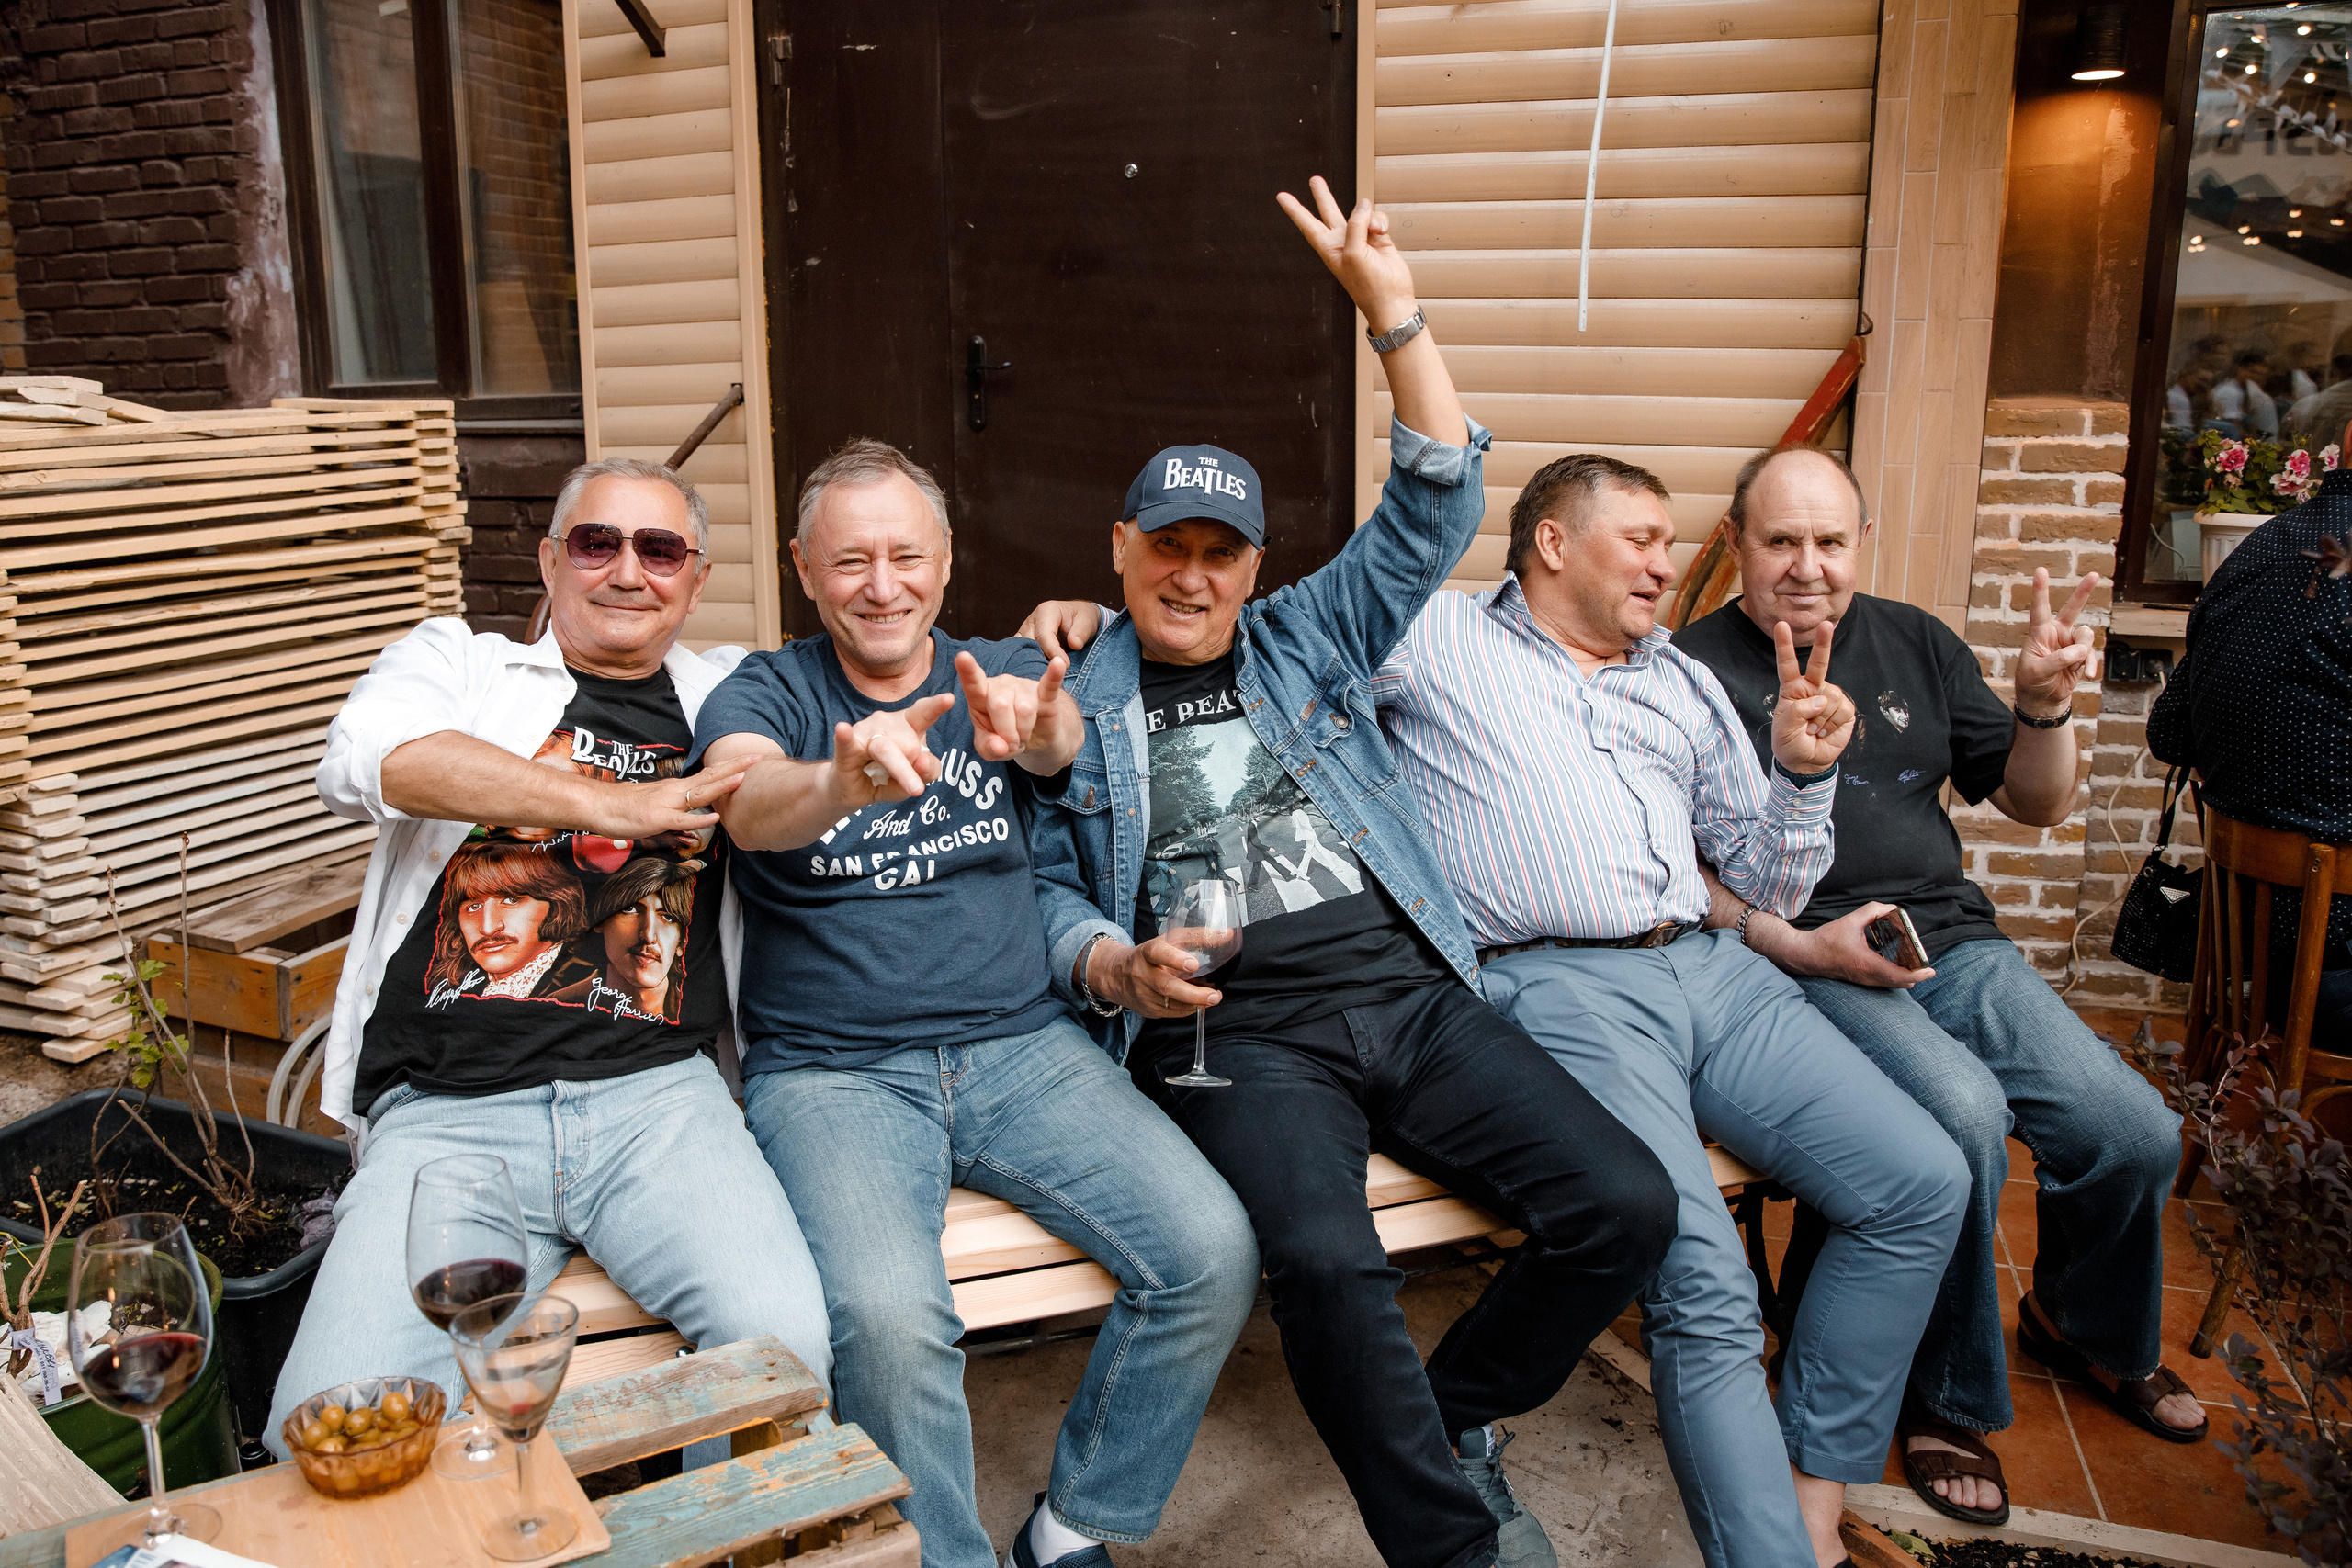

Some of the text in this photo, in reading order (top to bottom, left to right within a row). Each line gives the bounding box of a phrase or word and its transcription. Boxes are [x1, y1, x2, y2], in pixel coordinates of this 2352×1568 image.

[1198, 457, 1219, 468] THE
[1163, 458, 1247, 501] BEATLES
[1146, 709, 1167, 733] E
[571, 726, 656, 779] BEATLES
[611, 739, 634, 756] THE
[863, 809, 915, 840] And
[919, 795, 952, 825] Co.
[810, 855, 863, 876] SAN
